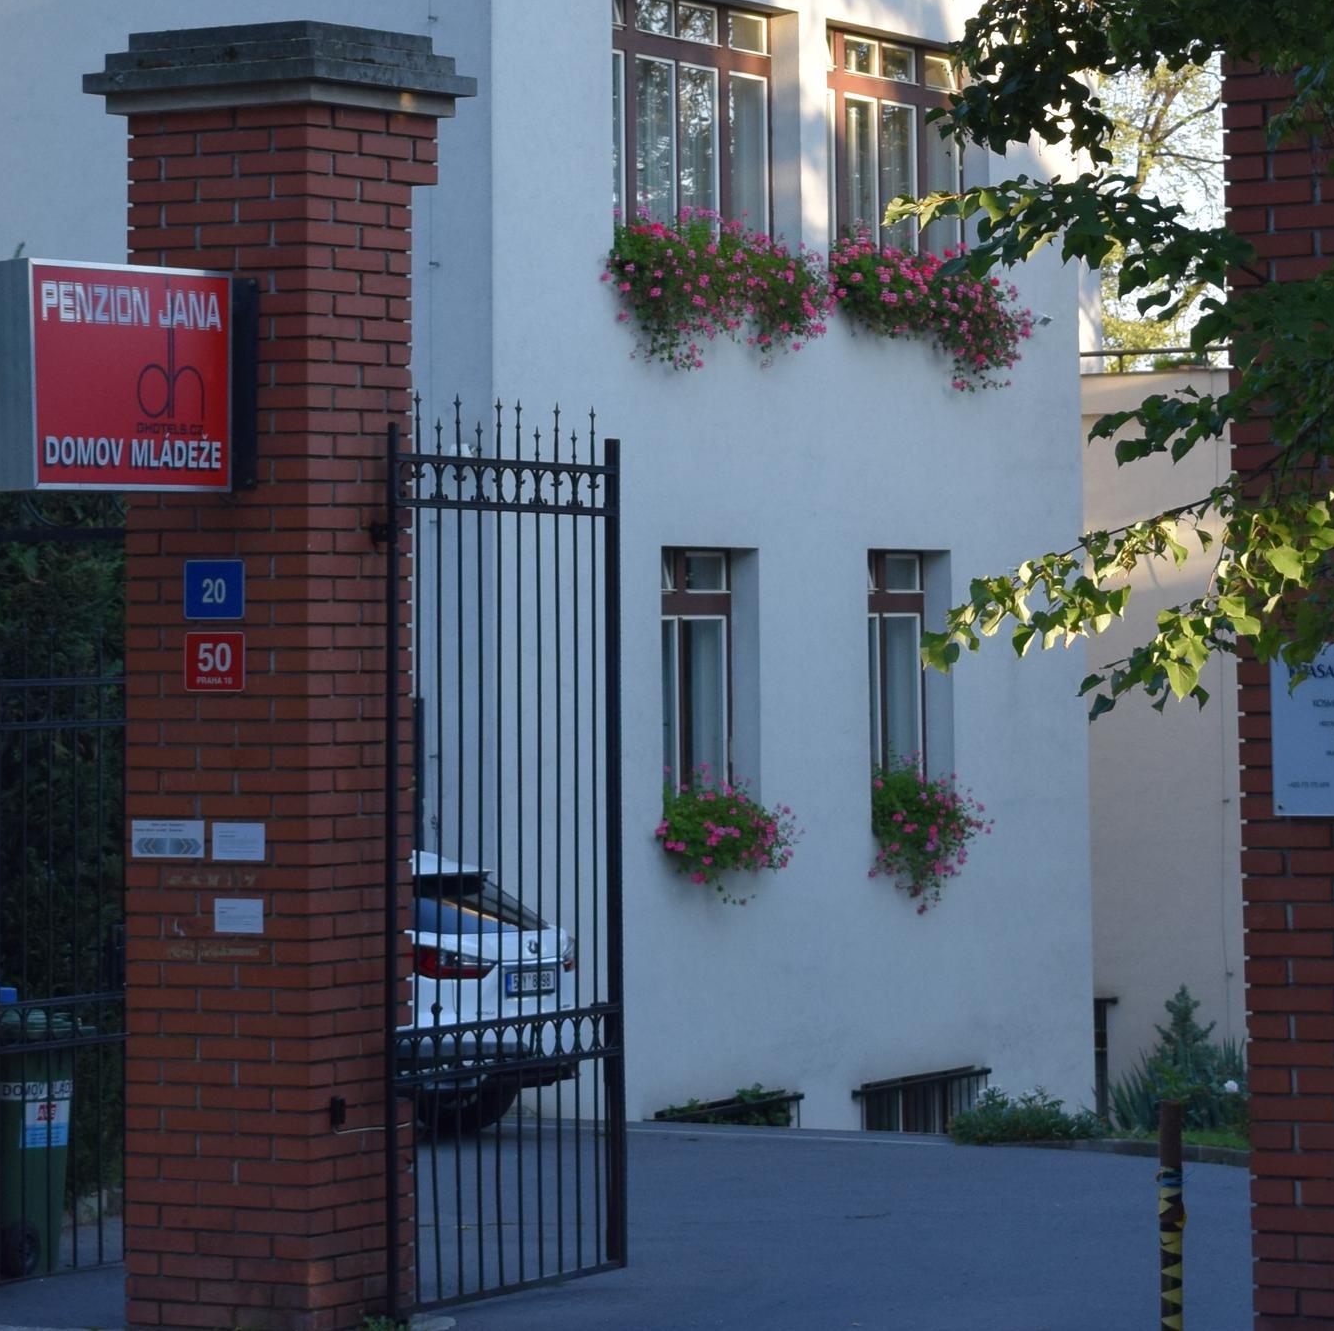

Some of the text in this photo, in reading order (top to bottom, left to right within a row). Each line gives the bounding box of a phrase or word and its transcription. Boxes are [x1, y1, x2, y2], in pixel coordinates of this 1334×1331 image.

[41, 280, 222, 332] PENZION JANA
[45, 433, 222, 469] DOMOV MLÁDEŽE
[202, 578, 226, 604] 20
[197, 642, 232, 672] 50
[196, 676, 233, 685] PRAHA 10
